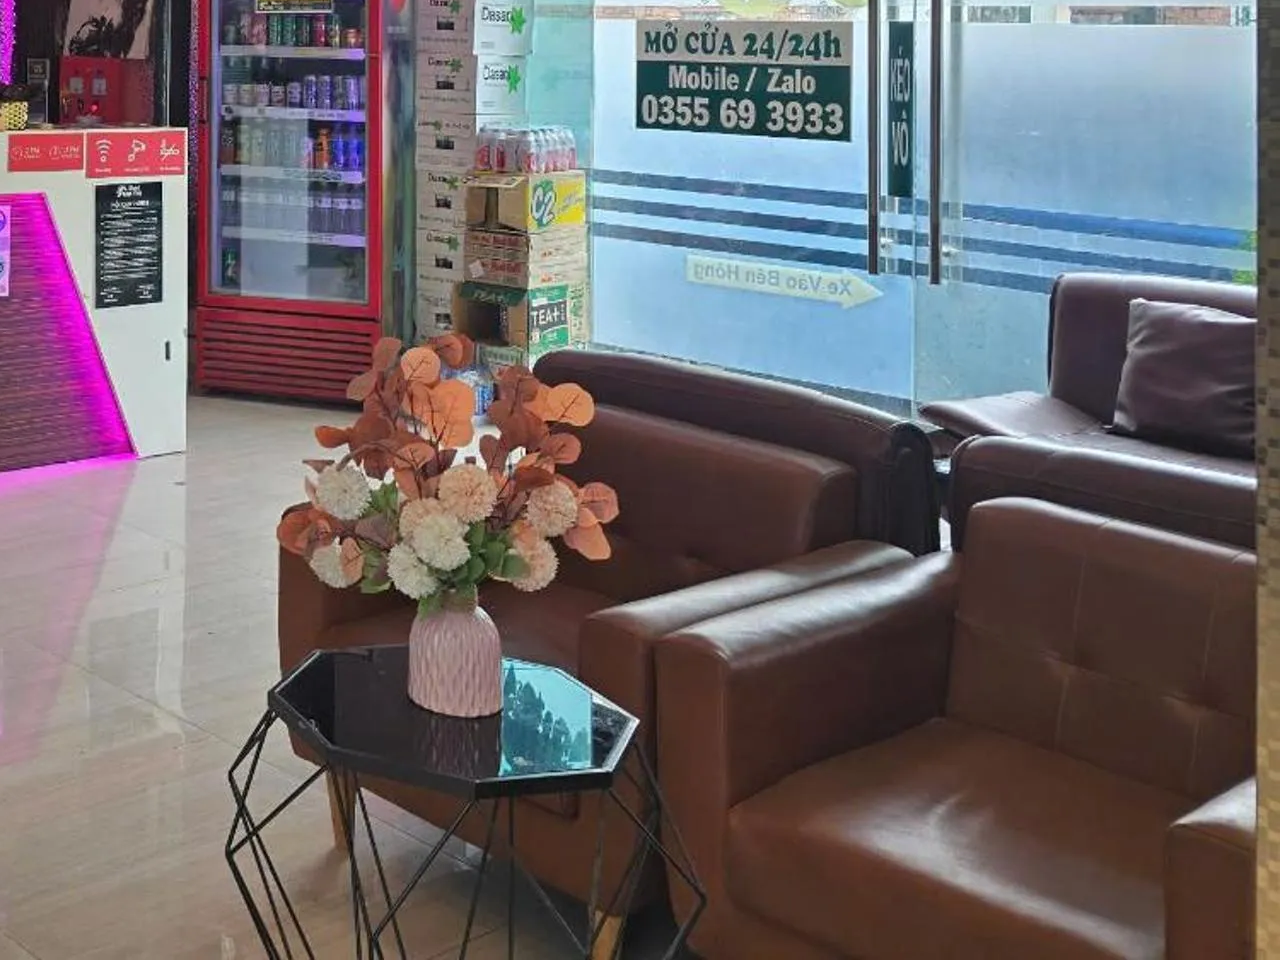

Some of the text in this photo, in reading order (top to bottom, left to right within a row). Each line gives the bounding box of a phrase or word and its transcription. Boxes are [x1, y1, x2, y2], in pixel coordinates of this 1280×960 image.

[644, 21, 842, 62] MỞ CỬA 24/24h
[669, 65, 816, 95] Mobile / Zalo
[890, 46, 911, 103] KÉO
[642, 94, 844, 135] 0355 69 3933
[891, 109, 909, 167] VÔ
[532, 187, 555, 224] C2
[530, 306, 560, 326] TEA+
